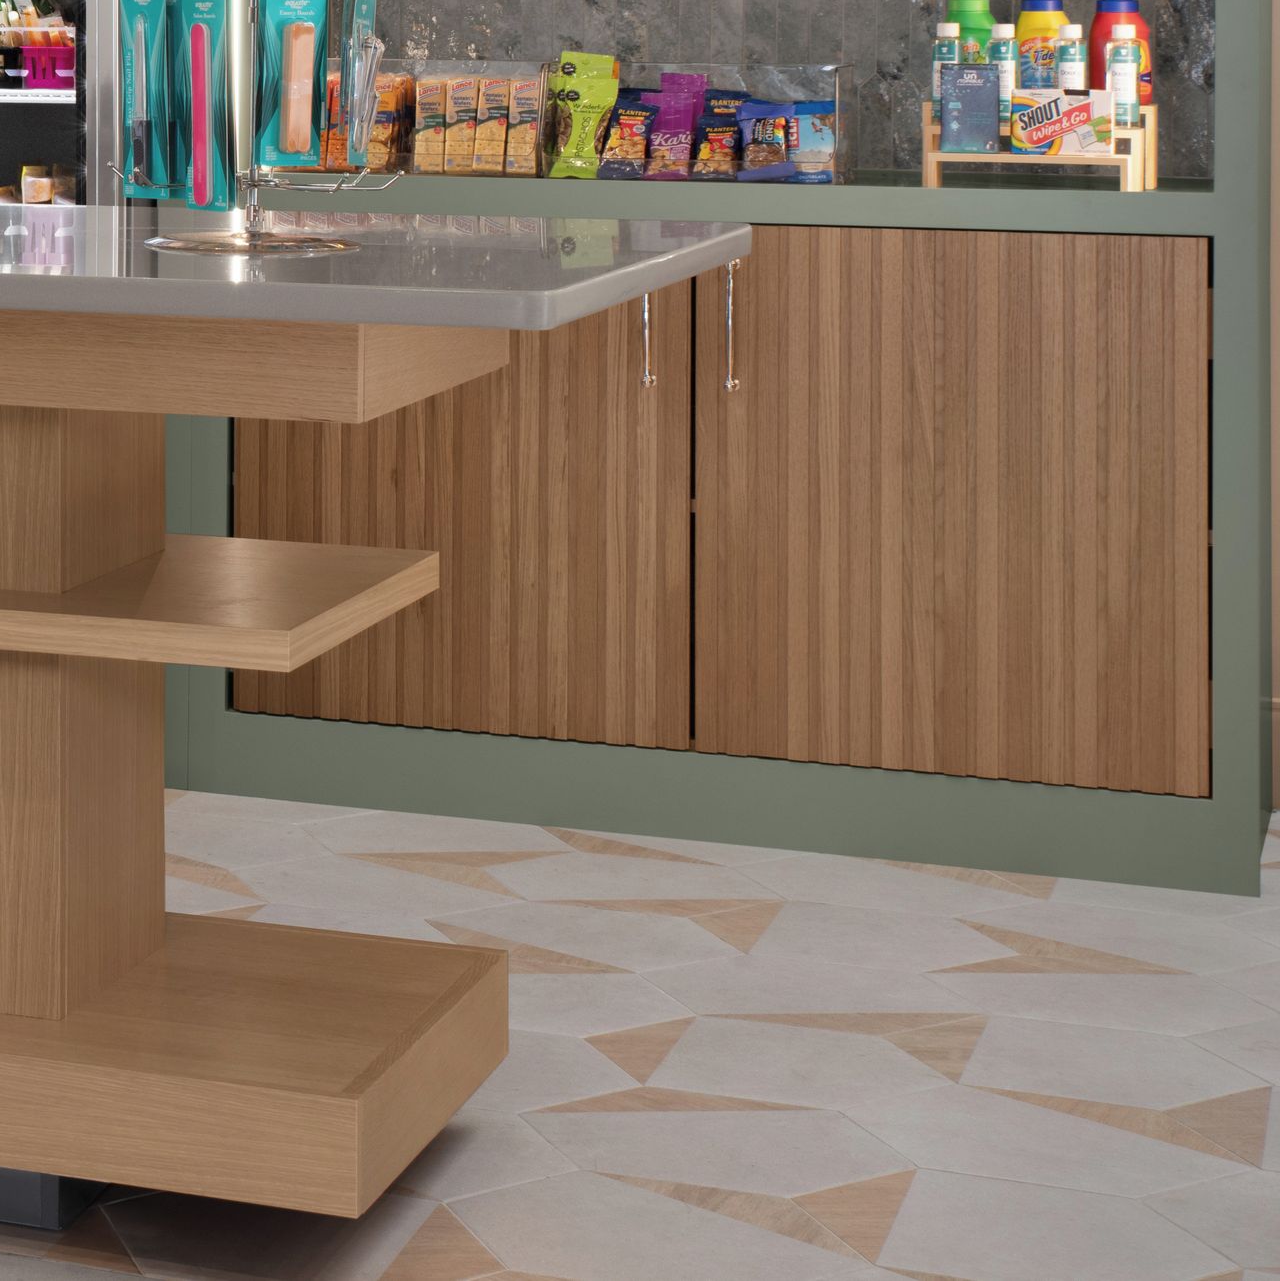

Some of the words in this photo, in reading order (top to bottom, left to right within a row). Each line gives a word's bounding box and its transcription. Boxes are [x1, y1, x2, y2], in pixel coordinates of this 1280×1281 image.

[452, 80, 473, 91] Lance
[484, 79, 507, 88] Lance
[515, 81, 537, 91] Lance
[419, 86, 440, 96] Lance
[1018, 97, 1062, 131] SHOUT
[765, 119, 774, 141] KIND
[1031, 123, 1061, 142] Wipe
[1071, 110, 1087, 126] Go
